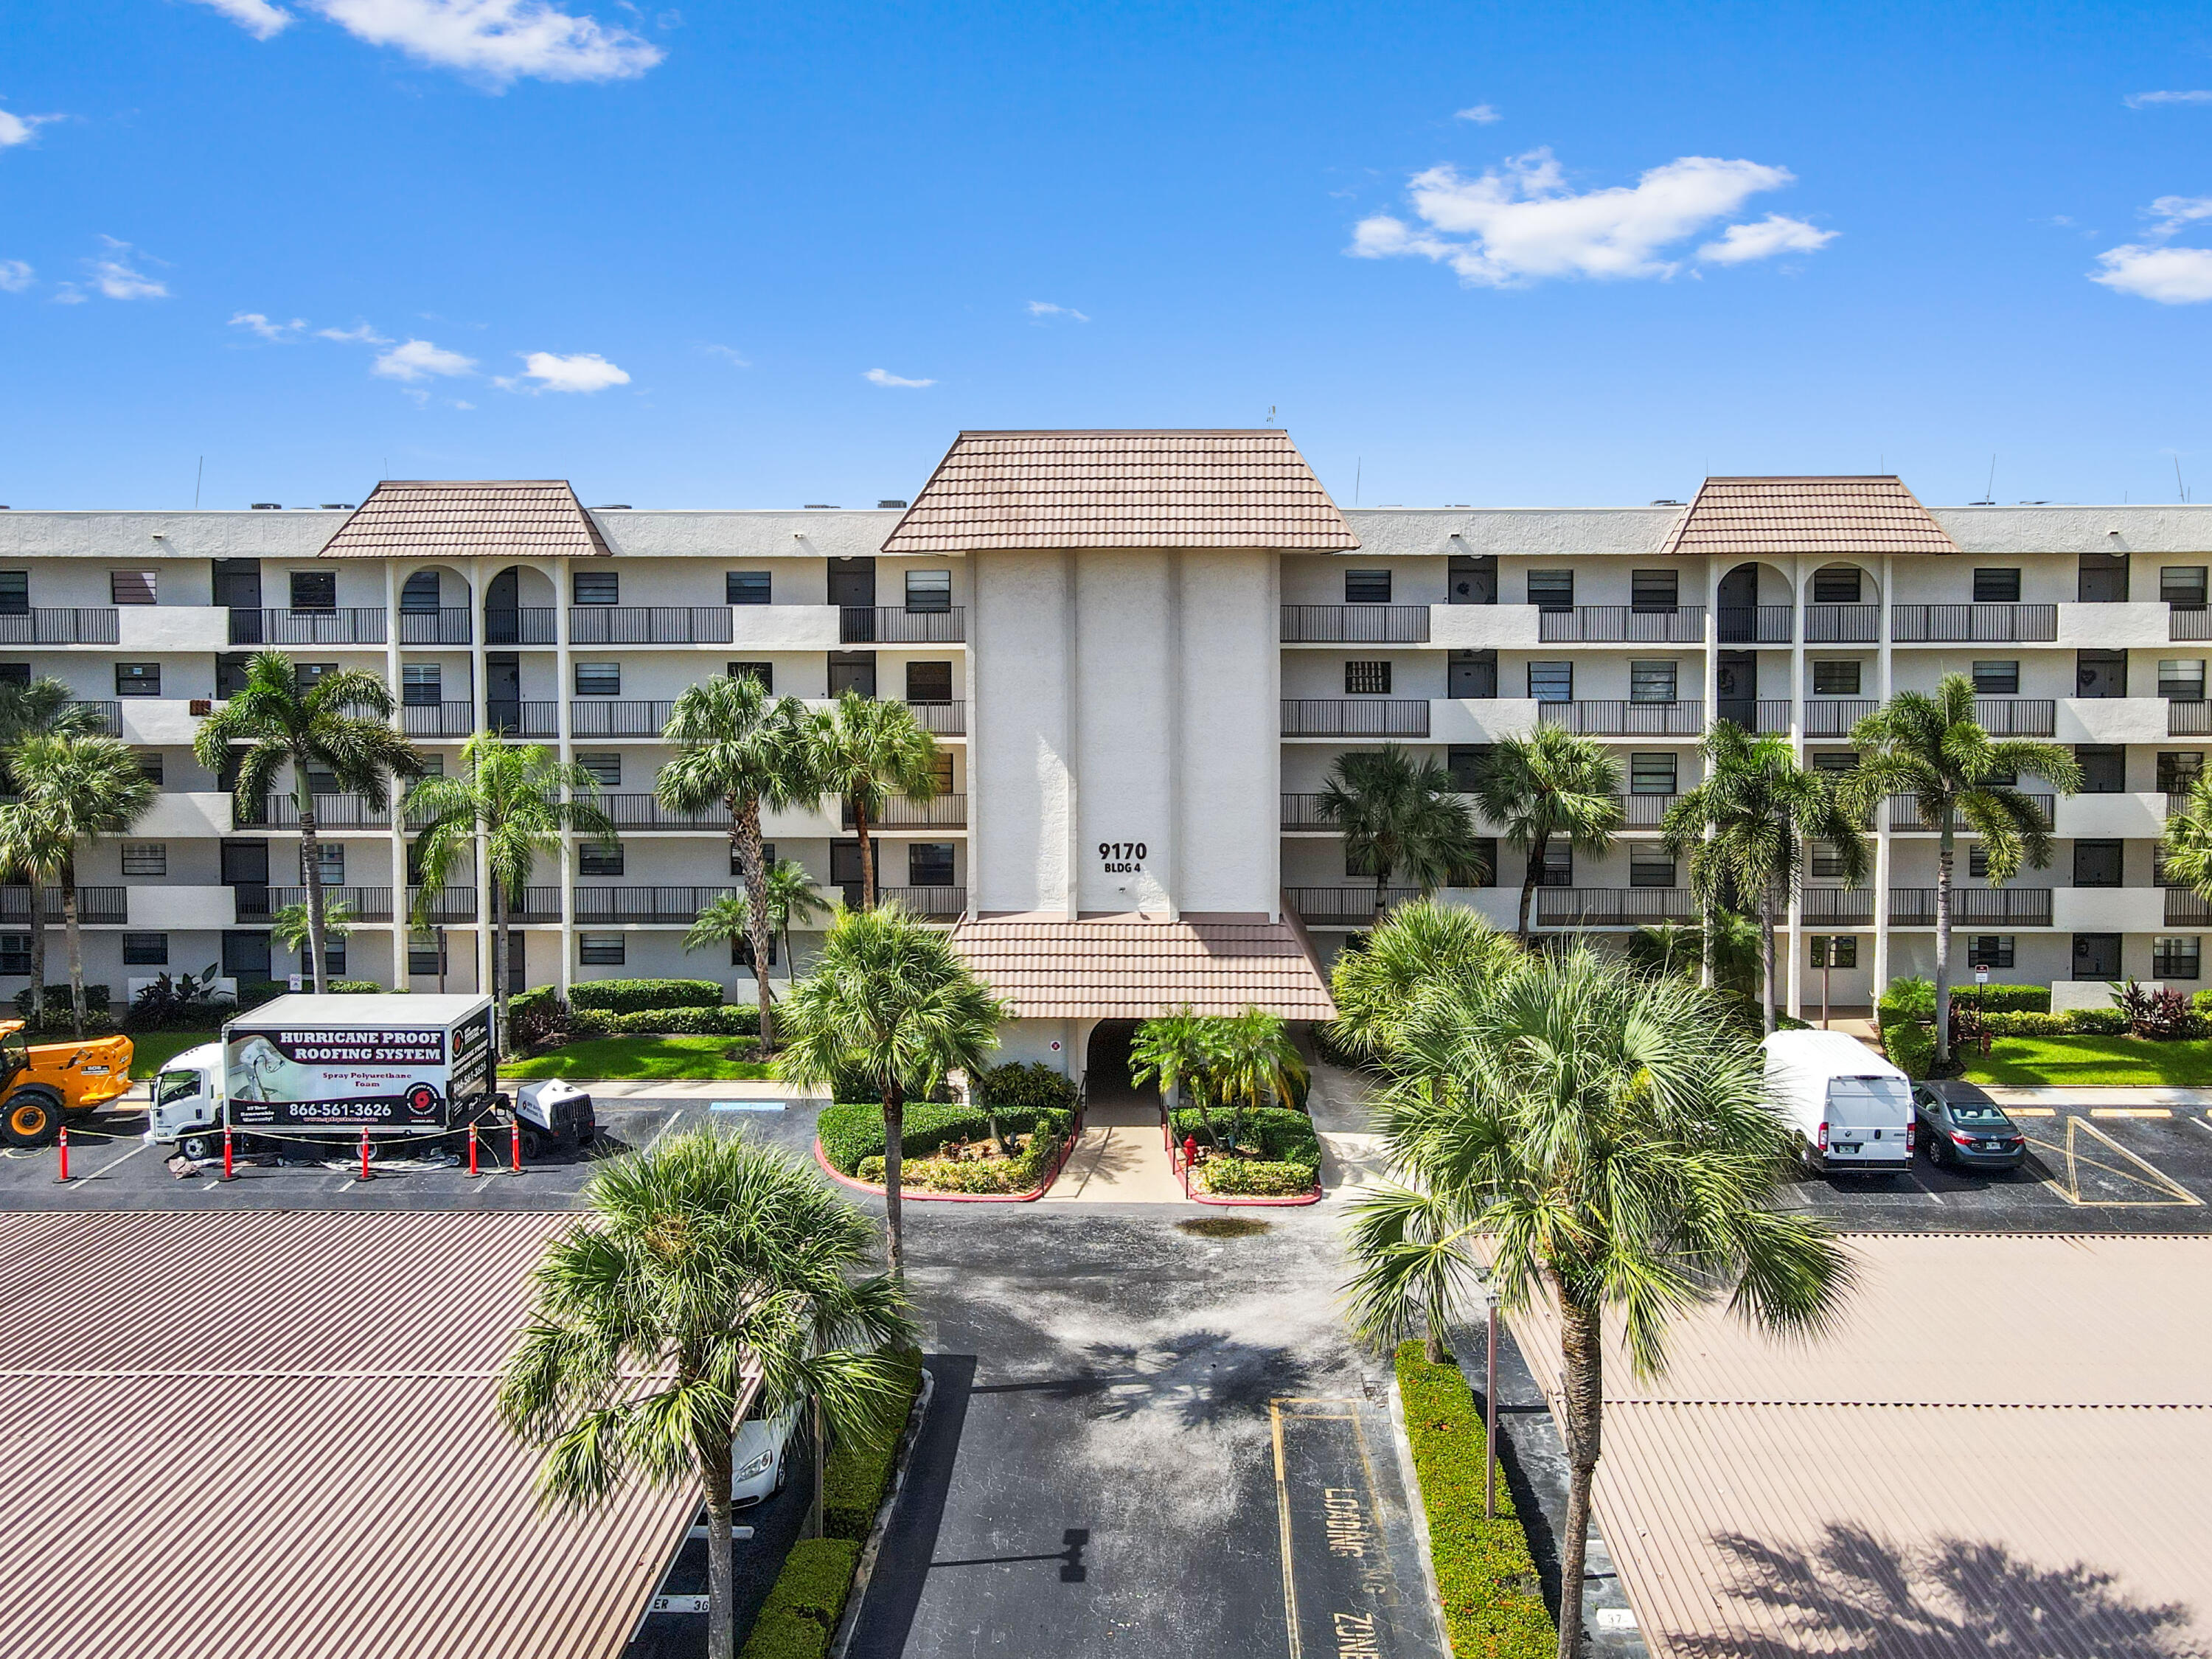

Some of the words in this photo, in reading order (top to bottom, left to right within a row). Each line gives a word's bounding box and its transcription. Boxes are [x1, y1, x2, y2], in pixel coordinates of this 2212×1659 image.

[1099, 843, 1147, 860] 9170
[1105, 863, 1132, 873] BLDG
[1134, 863, 1141, 873] 4
[280, 1032, 379, 1043] HURRICANE
[382, 1032, 441, 1043] PROOF
[295, 1048, 372, 1060] ROOFING
[375, 1048, 441, 1060] SYSTEM
[289, 1104, 392, 1116] 866-561-3626
[1324, 1488, 1365, 1558] LOADING
